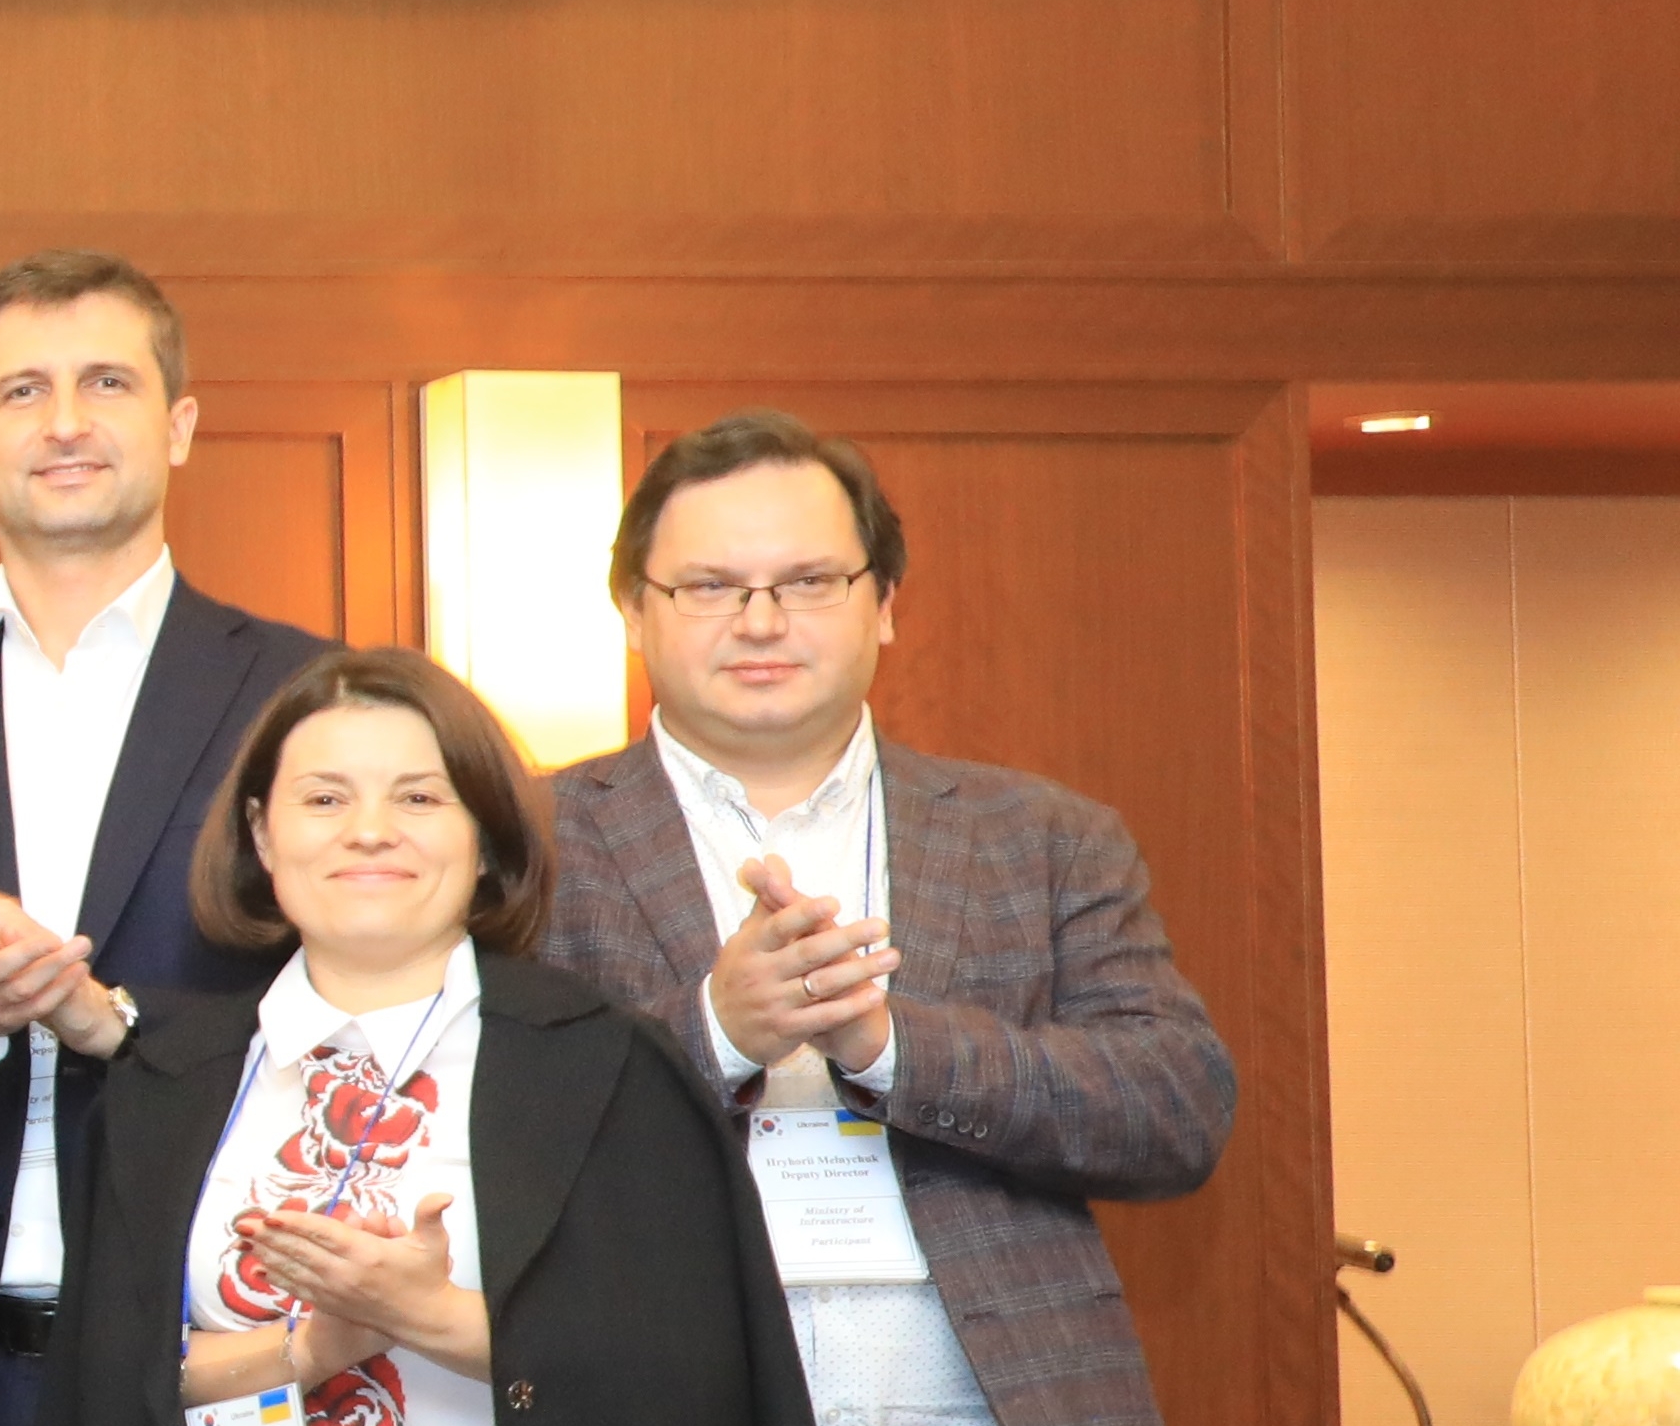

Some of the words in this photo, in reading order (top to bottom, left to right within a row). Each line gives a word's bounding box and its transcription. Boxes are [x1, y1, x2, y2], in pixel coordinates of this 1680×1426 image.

[781, 1170, 821, 1182] Deputy
[824, 1168, 870, 1178] Director
[804, 1206, 850, 1216] Ministry
[853, 1205, 865, 1214] of
[799, 1216, 875, 1226] Infrastructure
[811, 1237, 872, 1247] Participant
